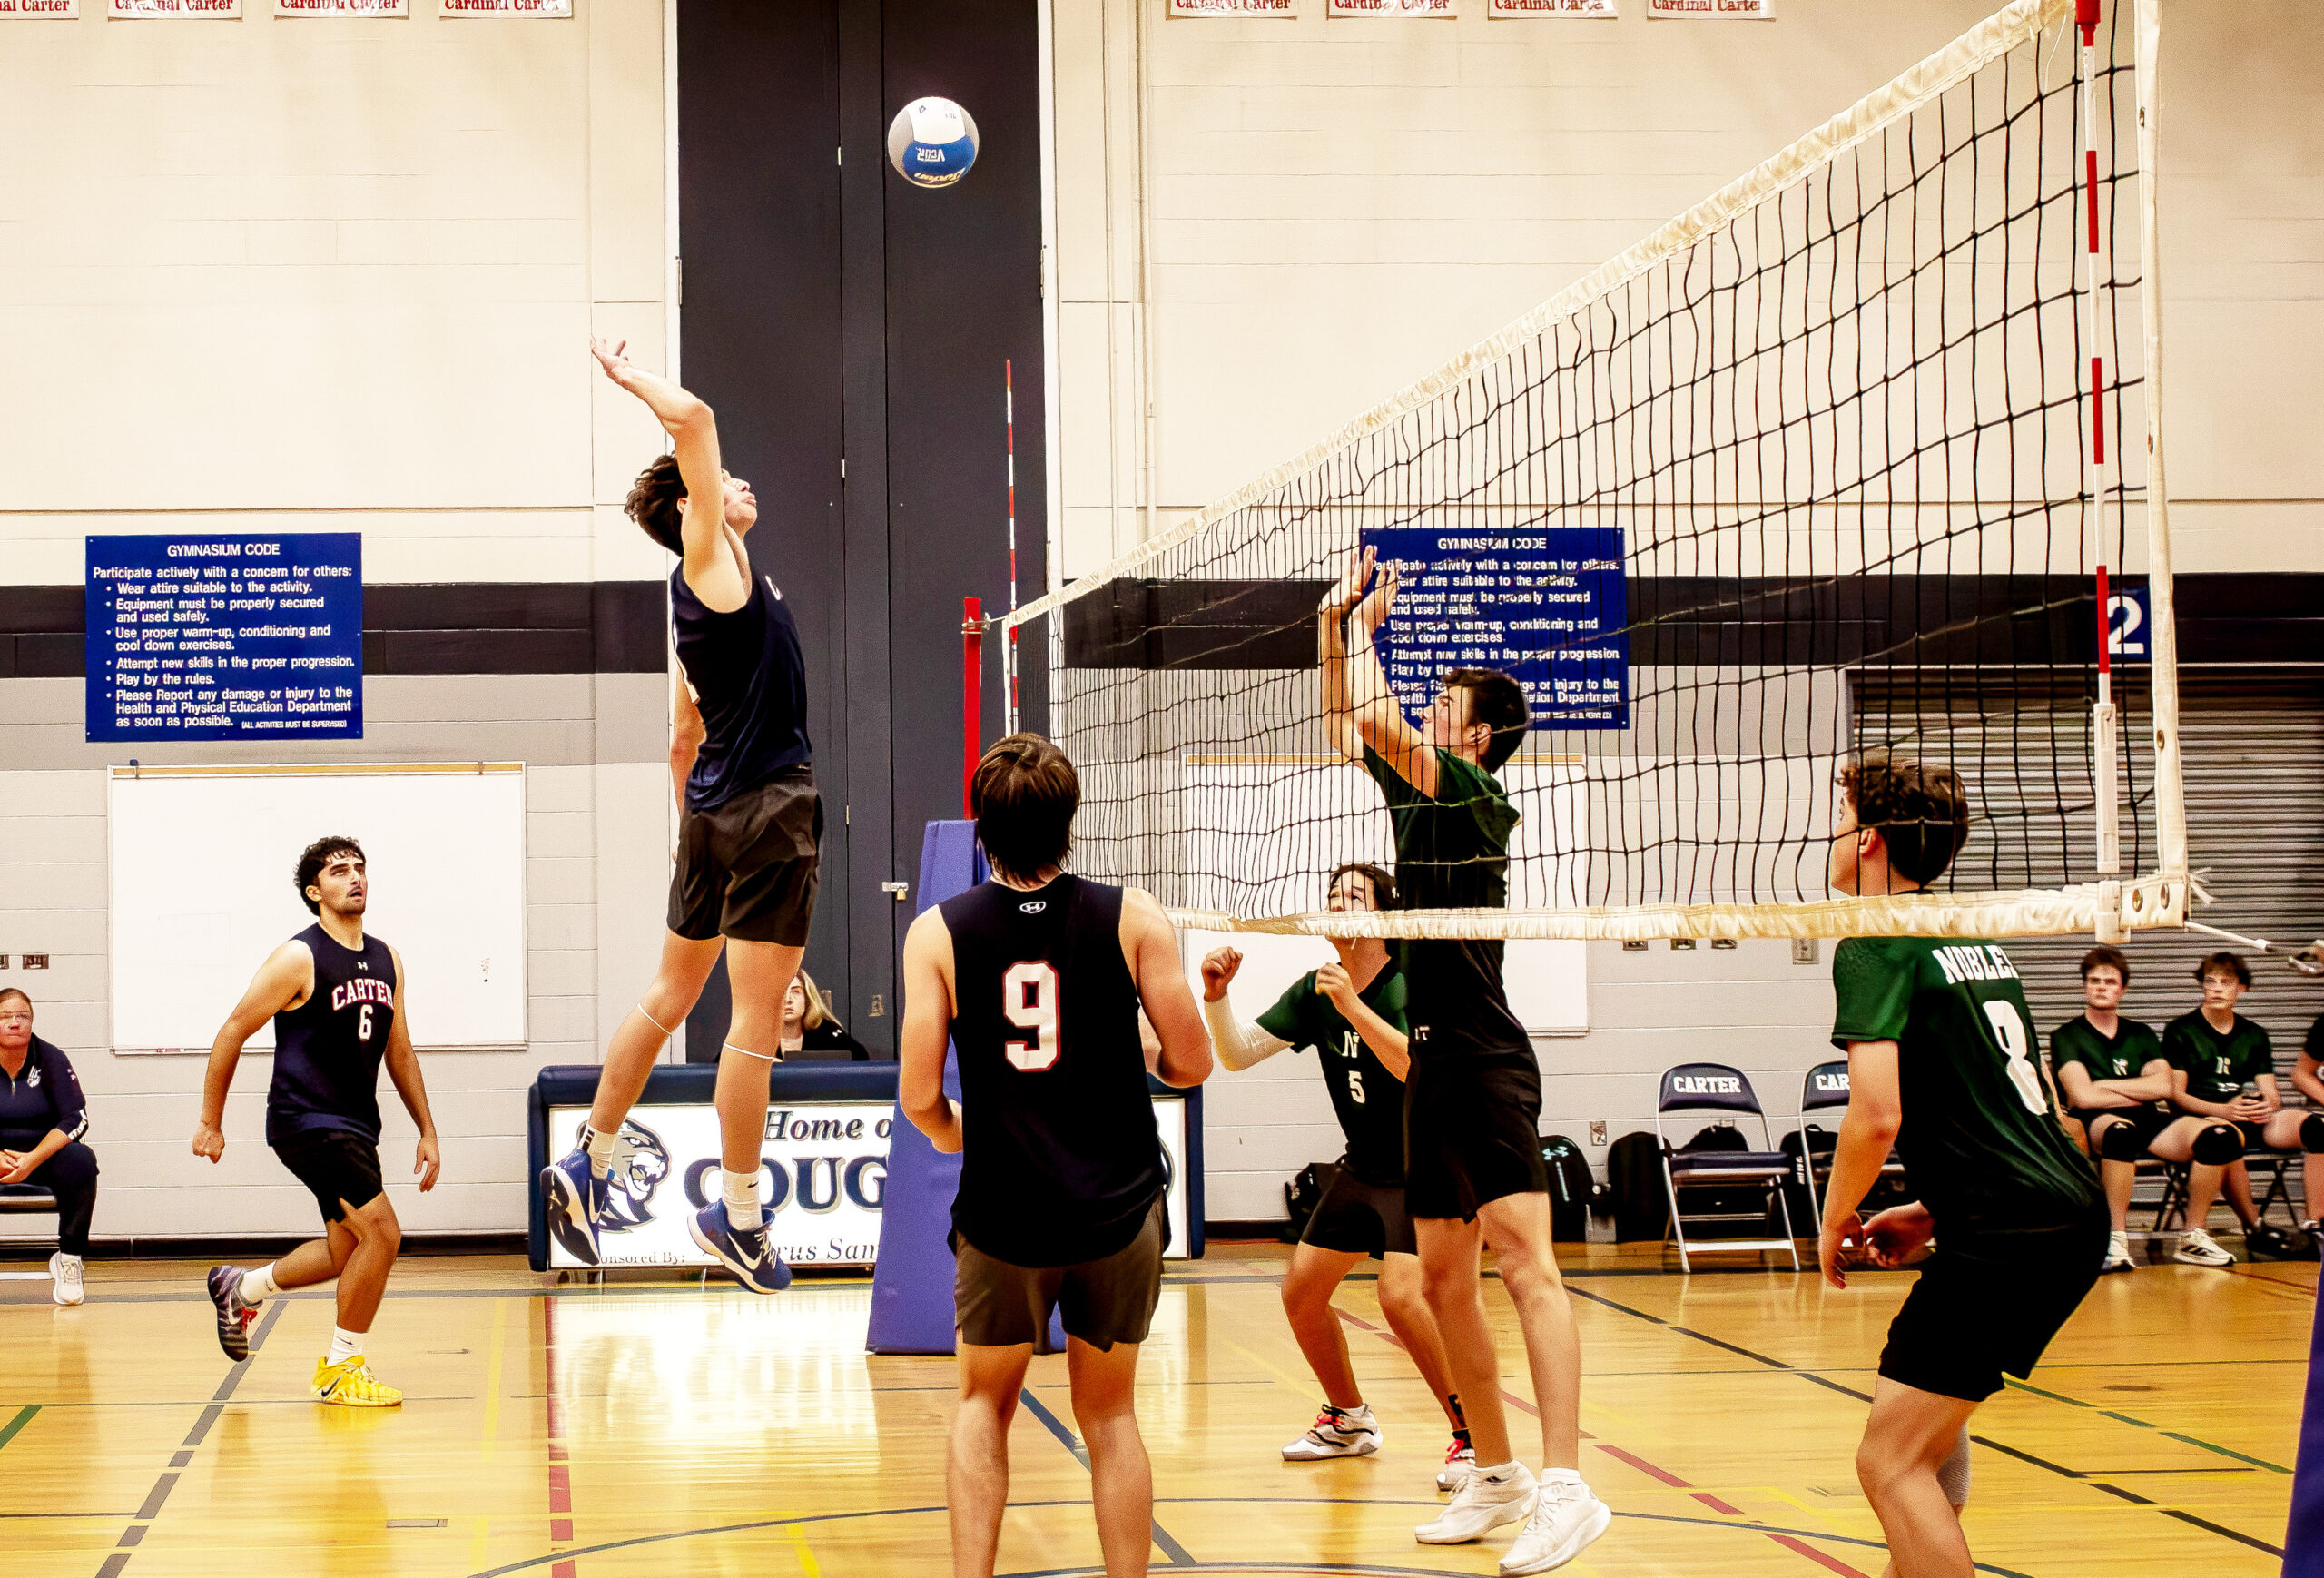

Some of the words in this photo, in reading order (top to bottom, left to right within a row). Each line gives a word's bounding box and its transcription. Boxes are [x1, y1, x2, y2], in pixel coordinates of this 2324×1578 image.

[22, 0, 69, 11] Carter
[115, 0, 180, 11] Canal
[350, 0, 399, 10] Cter
[1402, 0, 1449, 10] Cter
[1718, 0, 1761, 11] Carte
[167, 544, 240, 557] GYMNASIUM
[245, 544, 280, 555] CODE
[1512, 538, 1547, 550] CODE
[1476, 559, 1499, 571] with
[1502, 561, 1510, 571] a
[94, 567, 152, 580] Participate
[157, 567, 199, 579] actively
[204, 566, 226, 577] with
[231, 569, 238, 577] a
[243, 568, 288, 577] concern
[293, 566, 309, 577] for
[314, 565, 351, 577] others:
[1398, 575, 1417, 587] ear
[1422, 575, 1448, 587] attire
[1452, 574, 1495, 587] suitable
[1499, 575, 1511, 586] to
[1515, 575, 1532, 586] the
[117, 583, 145, 594] Wear
[150, 582, 179, 594] attire
[183, 581, 226, 593] suitable
[231, 582, 242, 593] to
[247, 581, 265, 592] the
[270, 581, 312, 594] activity.
[116, 598, 174, 612] Equipment
[179, 598, 206, 609] must
[211, 597, 225, 608] be
[230, 597, 275, 611] properly
[280, 597, 324, 608] secured
[1393, 592, 1446, 605] quipment
[1480, 591, 1495, 603] be
[1548, 591, 1590, 603] secured
[1390, 604, 1411, 615] and
[1414, 604, 1442, 616] used
[116, 611, 137, 623] and
[142, 611, 169, 622] used
[173, 611, 209, 624] safely.
[1390, 619, 1411, 631] Use
[1510, 618, 1574, 631] conditioning
[1577, 617, 1598, 630] and
[2107, 595, 2144, 654] 2
[115, 627, 139, 638] Use
[143, 629, 178, 641] proper
[183, 628, 234, 640] warm-up,
[240, 625, 305, 638] conditioning
[310, 624, 330, 636] and
[1418, 632, 1448, 644] down
[116, 639, 140, 651] cool
[143, 638, 174, 651] down
[179, 638, 234, 650] exercises.
[1461, 647, 1486, 660] skills
[1490, 647, 1499, 660] in
[1503, 648, 1519, 660] the
[116, 657, 158, 671] Attempt
[162, 660, 183, 668] new
[188, 656, 213, 668] skills
[218, 656, 227, 667] in
[231, 656, 248, 667] the
[252, 658, 287, 669] proper
[291, 656, 354, 669] progression.
[1436, 664, 1452, 676] the
[117, 674, 139, 686] Play
[145, 674, 157, 686] by
[163, 673, 180, 684] the
[186, 673, 214, 684] rules.
[1392, 680, 1426, 691] Pleas
[1540, 682, 1550, 690] or
[1587, 679, 1599, 690] to
[1603, 678, 1619, 690] the
[116, 690, 152, 700] Please
[156, 689, 192, 702] Report
[198, 691, 217, 702] any
[222, 688, 265, 702] damage
[270, 690, 281, 699] or
[286, 687, 314, 701] injury
[319, 687, 330, 698] to
[335, 686, 352, 698] the
[1399, 693, 1426, 705] ealth
[116, 702, 152, 714] Health
[156, 701, 176, 714] and
[181, 701, 225, 715] Physical
[230, 701, 283, 712] Education
[288, 700, 351, 714] Department
[116, 718, 130, 726] as
[134, 717, 162, 726] soon
[166, 717, 180, 726] as
[184, 715, 233, 728] possible.
[332, 978, 395, 1011] CARTER
[359, 1003, 374, 1041] 6
[1002, 960, 1060, 1072] 9
[1983, 1000, 2049, 1116] 8
[1348, 1070, 1366, 1104] 5
[1673, 1076, 1742, 1094] CARTER
[1816, 1073, 1850, 1090] CAR
[764, 1110, 864, 1142] Home
[684, 1154, 889, 1216] COUG
[600, 1252, 656, 1265] onsored
[663, 1251, 685, 1265] By:
